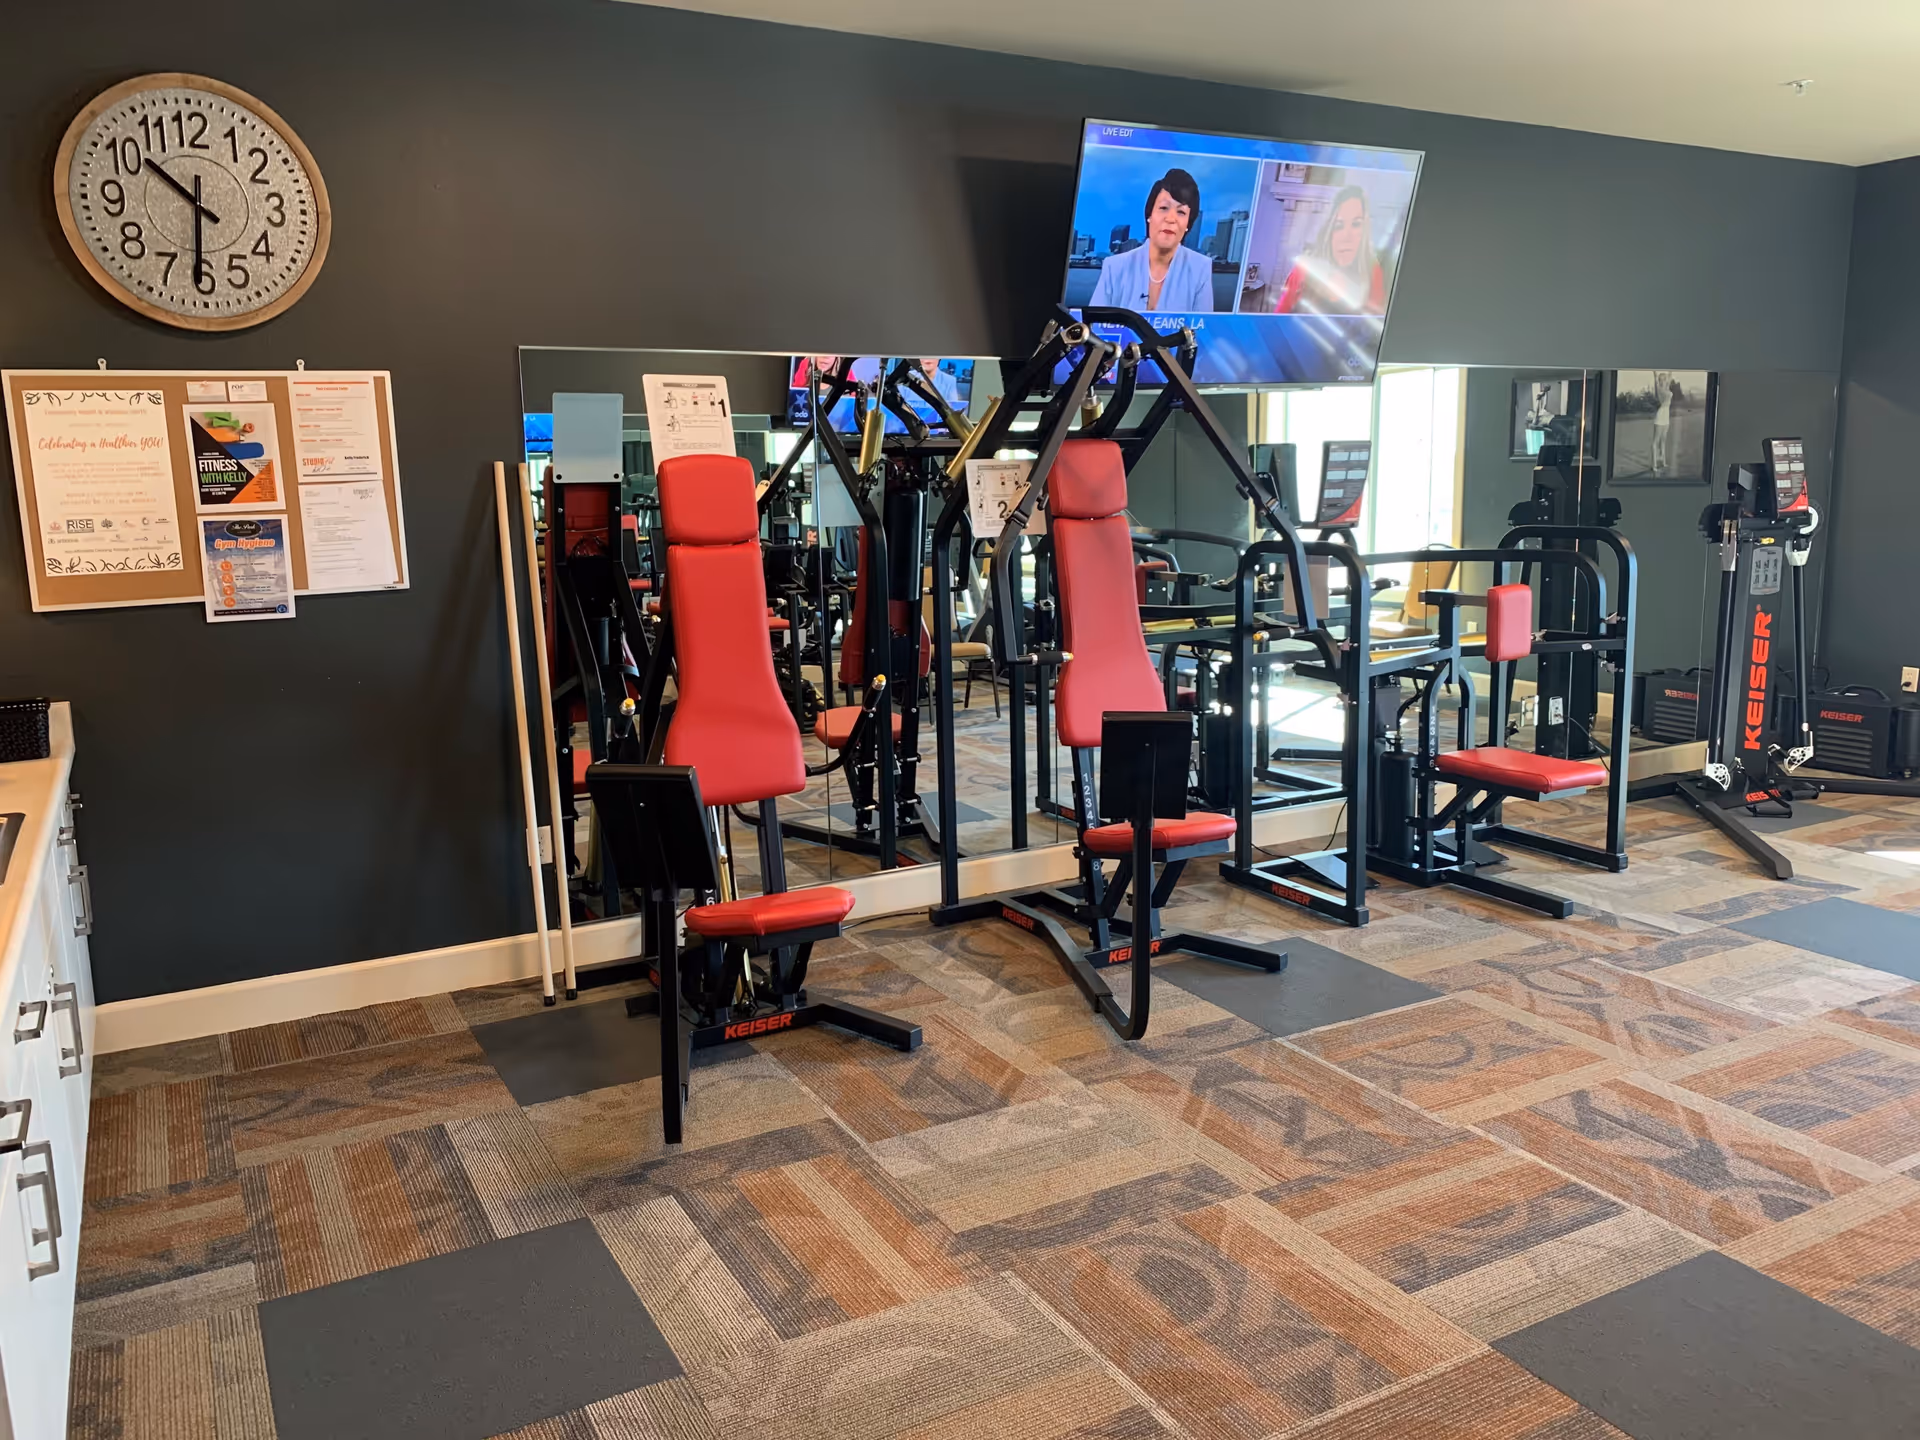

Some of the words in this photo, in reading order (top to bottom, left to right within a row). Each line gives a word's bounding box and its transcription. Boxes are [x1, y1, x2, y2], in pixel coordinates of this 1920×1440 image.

[138, 114, 167, 153] 11
[171, 109, 210, 150] 12
[1102, 127, 1118, 136] LIVE
[1119, 128, 1134, 137] EDT
[223, 126, 239, 163] 1
[105, 136, 141, 176] 10
[248, 147, 270, 185] 2
[100, 179, 125, 217] 9
[264, 191, 286, 228] 3
[119, 221, 146, 259] 8
[251, 230, 274, 263] 4
[155, 252, 178, 287] 7
[193, 258, 216, 295] 6
[226, 254, 250, 289] 5
[1190, 317, 1205, 330] LA
[718, 398, 727, 418] 1
[38, 435, 87, 453] Celebrating
[99, 432, 137, 450] Healthier
[198, 459, 238, 472] FITNESS
[200, 472, 223, 484] WITH
[223, 472, 247, 483] KELLY
[997, 500, 1008, 519] 2
[67, 519, 94, 530] RISE
[215, 538, 236, 550] Gym
[237, 538, 276, 550] Hygiene
[1744, 611, 1772, 750] KEISER
[1820, 710, 1864, 724] KEISER
[1430, 727, 1436, 736] 3
[1430, 748, 1435, 757] 5
[1430, 760, 1435, 768] 6
[1083, 773, 1089, 782] 1
[1084, 786, 1091, 795] 2
[1086, 798, 1092, 808] 3
[1087, 810, 1094, 820] 4
[1093, 861, 1100, 871] 8
[1272, 883, 1310, 906] KEISER
[1002, 906, 1034, 930] KEISER
[1108, 940, 1161, 964] KEIR
[724, 1012, 793, 1040] KEISER
